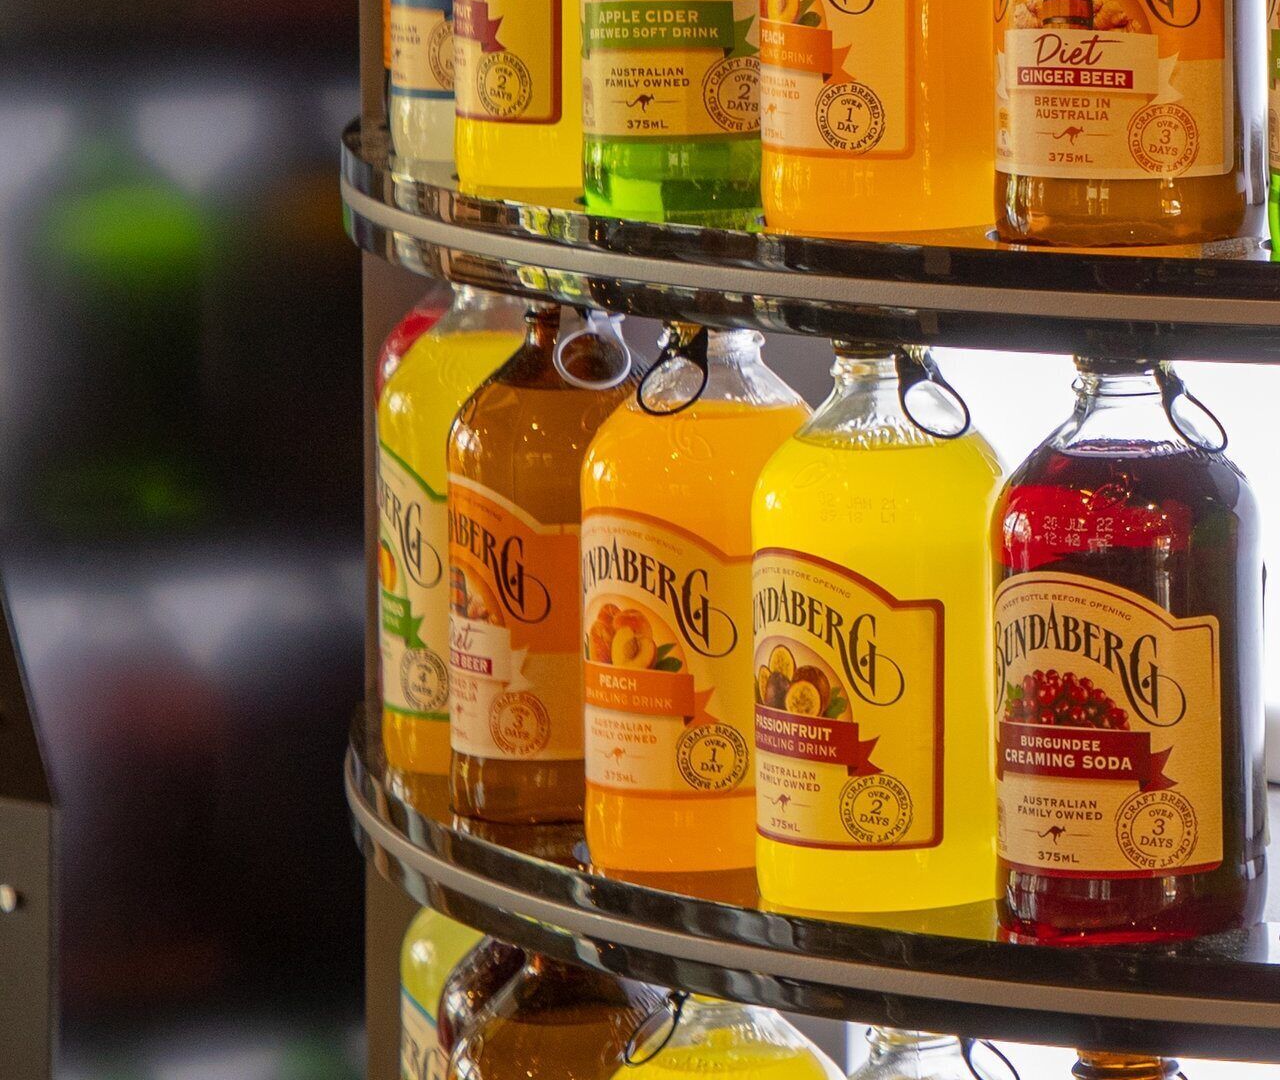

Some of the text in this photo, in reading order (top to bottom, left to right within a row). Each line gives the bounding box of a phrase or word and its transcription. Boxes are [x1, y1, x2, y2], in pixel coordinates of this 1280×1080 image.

[599, 10, 698, 24] APPLE CIDER
[632, 27, 666, 38] SOFT
[673, 28, 718, 38] DRINK
[1034, 33, 1124, 66] Diet
[1021, 70, 1126, 86] GINGER BEER
[841, 98, 863, 109] OVER
[1034, 96, 1110, 109] BREWED IN
[1036, 109, 1109, 121] AUSTRALIA
[837, 121, 859, 134] DAY
[599, 673, 637, 691] PEACH
[798, 743, 837, 757] DRINK
[1021, 736, 1100, 751] BURGUNDEE
[1005, 749, 1132, 770] CREAMING SODA
[1023, 795, 1097, 809] AUSTRALIAN
[1018, 805, 1102, 820] FAMILY OWNED
